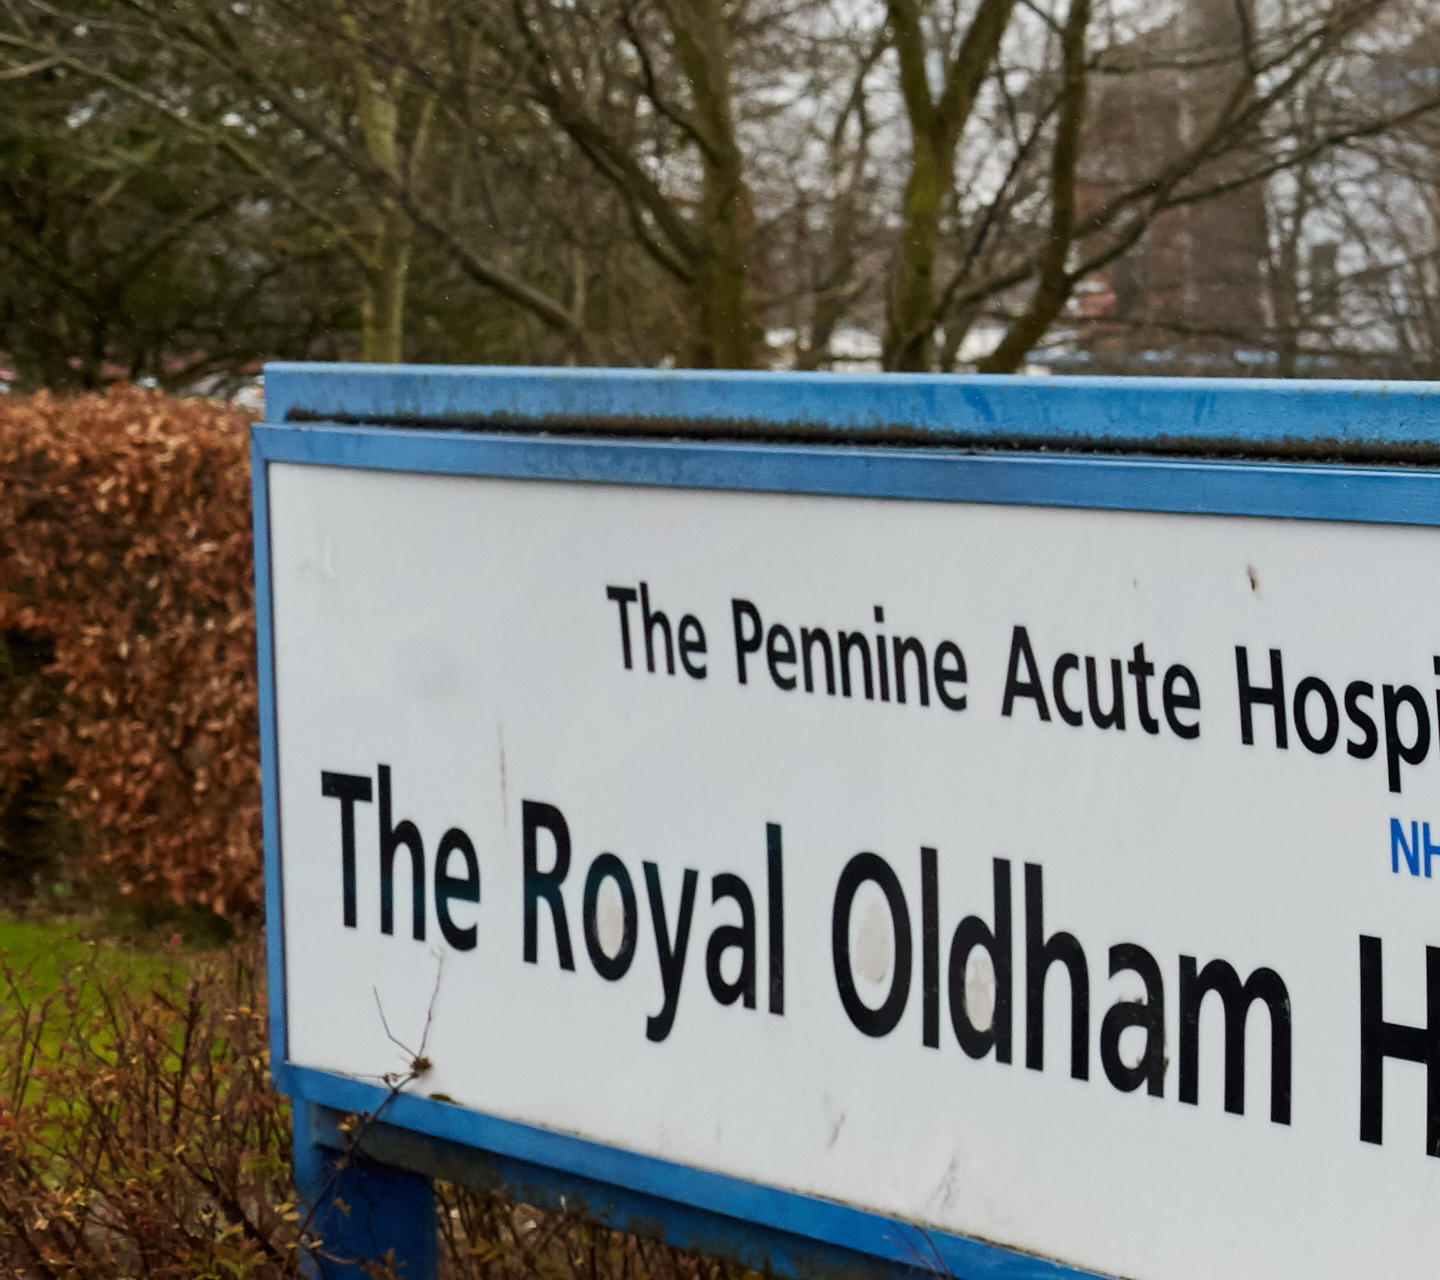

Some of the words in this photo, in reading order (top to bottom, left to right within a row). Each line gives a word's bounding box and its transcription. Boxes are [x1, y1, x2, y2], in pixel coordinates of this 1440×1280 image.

[606, 581, 708, 680] The
[731, 598, 968, 712] Pennine
[1001, 625, 1201, 740] Acute
[320, 763, 481, 952] The
[521, 799, 785, 1043] Royal
[831, 846, 1292, 1126] Oldham
